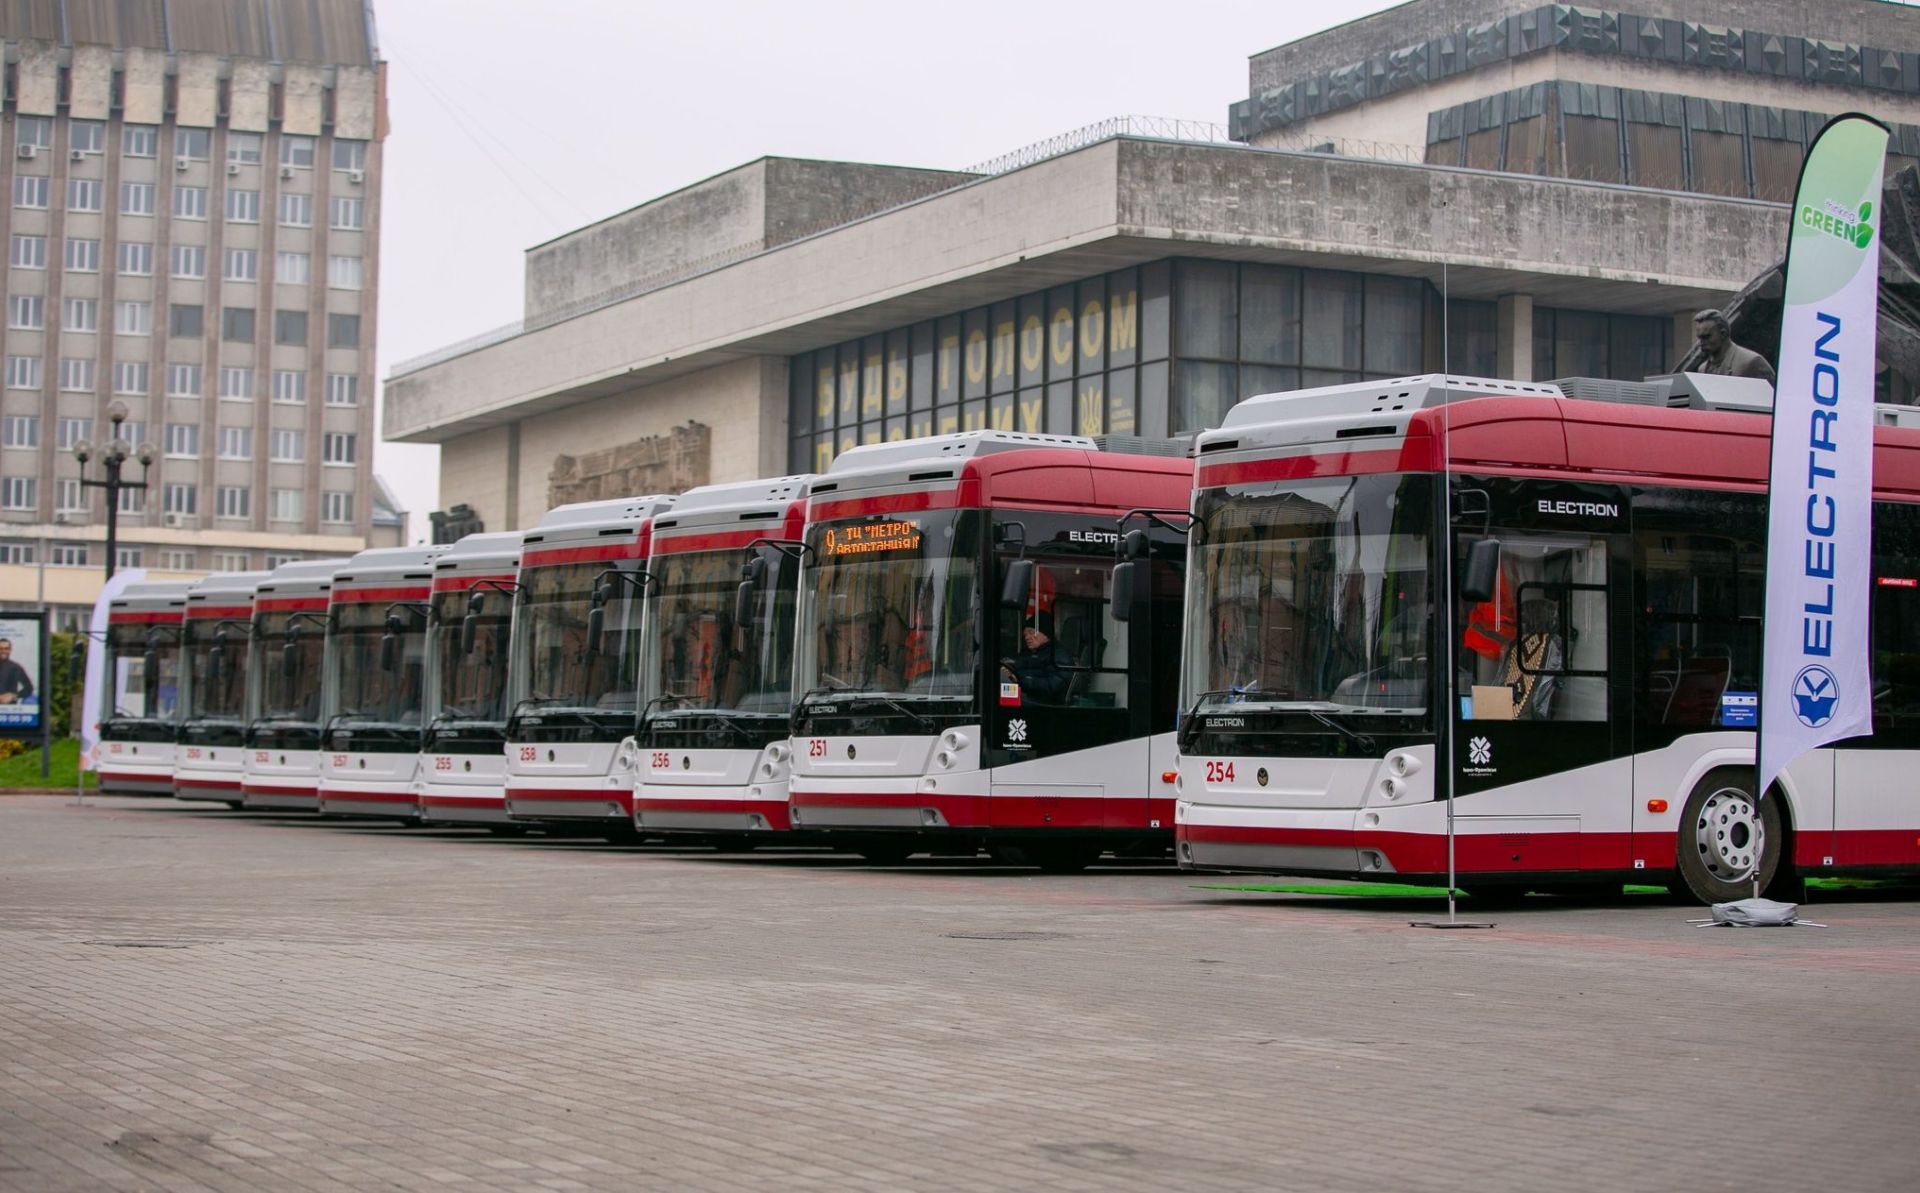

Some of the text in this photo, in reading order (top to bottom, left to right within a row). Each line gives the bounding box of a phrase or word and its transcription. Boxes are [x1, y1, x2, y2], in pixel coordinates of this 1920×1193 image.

[1802, 206, 1856, 243] GREEN
[816, 291, 1137, 417] БУДЬ ГОЛОСОМ
[1802, 311, 1842, 657] ELECTRON
[1538, 500, 1618, 517] ELECTRON
[845, 526, 862, 540] ТЦ
[1069, 531, 1119, 543] ELECTR
[826, 529, 835, 555] 9
[808, 705, 838, 714] ELECTRON
[1205, 718, 1245, 727] ELECTRON
[520, 747, 536, 760] 258
[810, 739, 827, 756] 251
[651, 752, 670, 767] 256
[1206, 761, 1235, 782] 254
